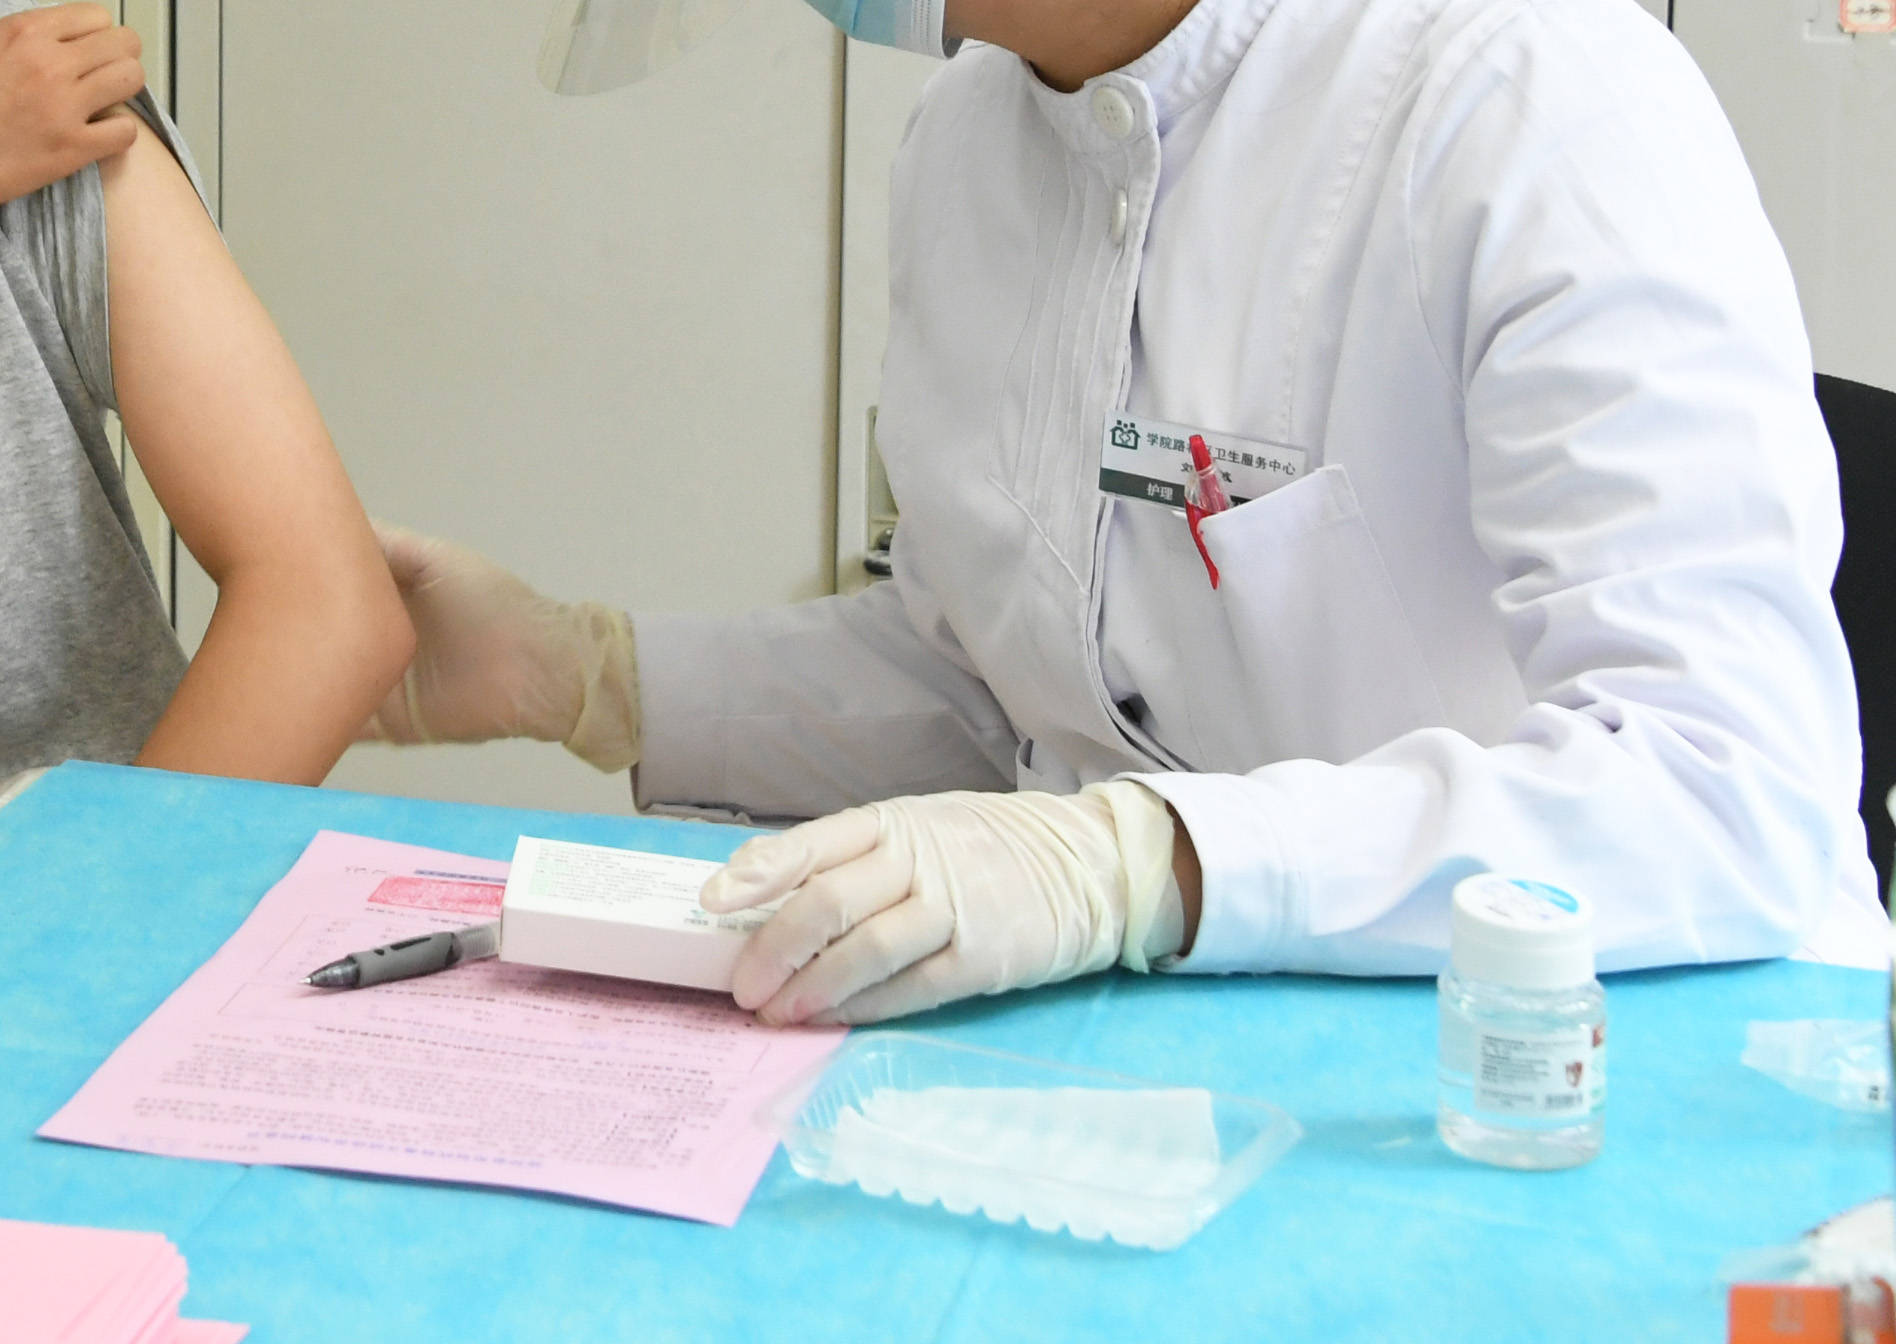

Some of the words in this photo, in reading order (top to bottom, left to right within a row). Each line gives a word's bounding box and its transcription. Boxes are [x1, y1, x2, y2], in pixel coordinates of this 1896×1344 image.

[1146, 432, 1296, 476] 学院路卫生服务中心
[1146, 482, 1174, 501] 护理
